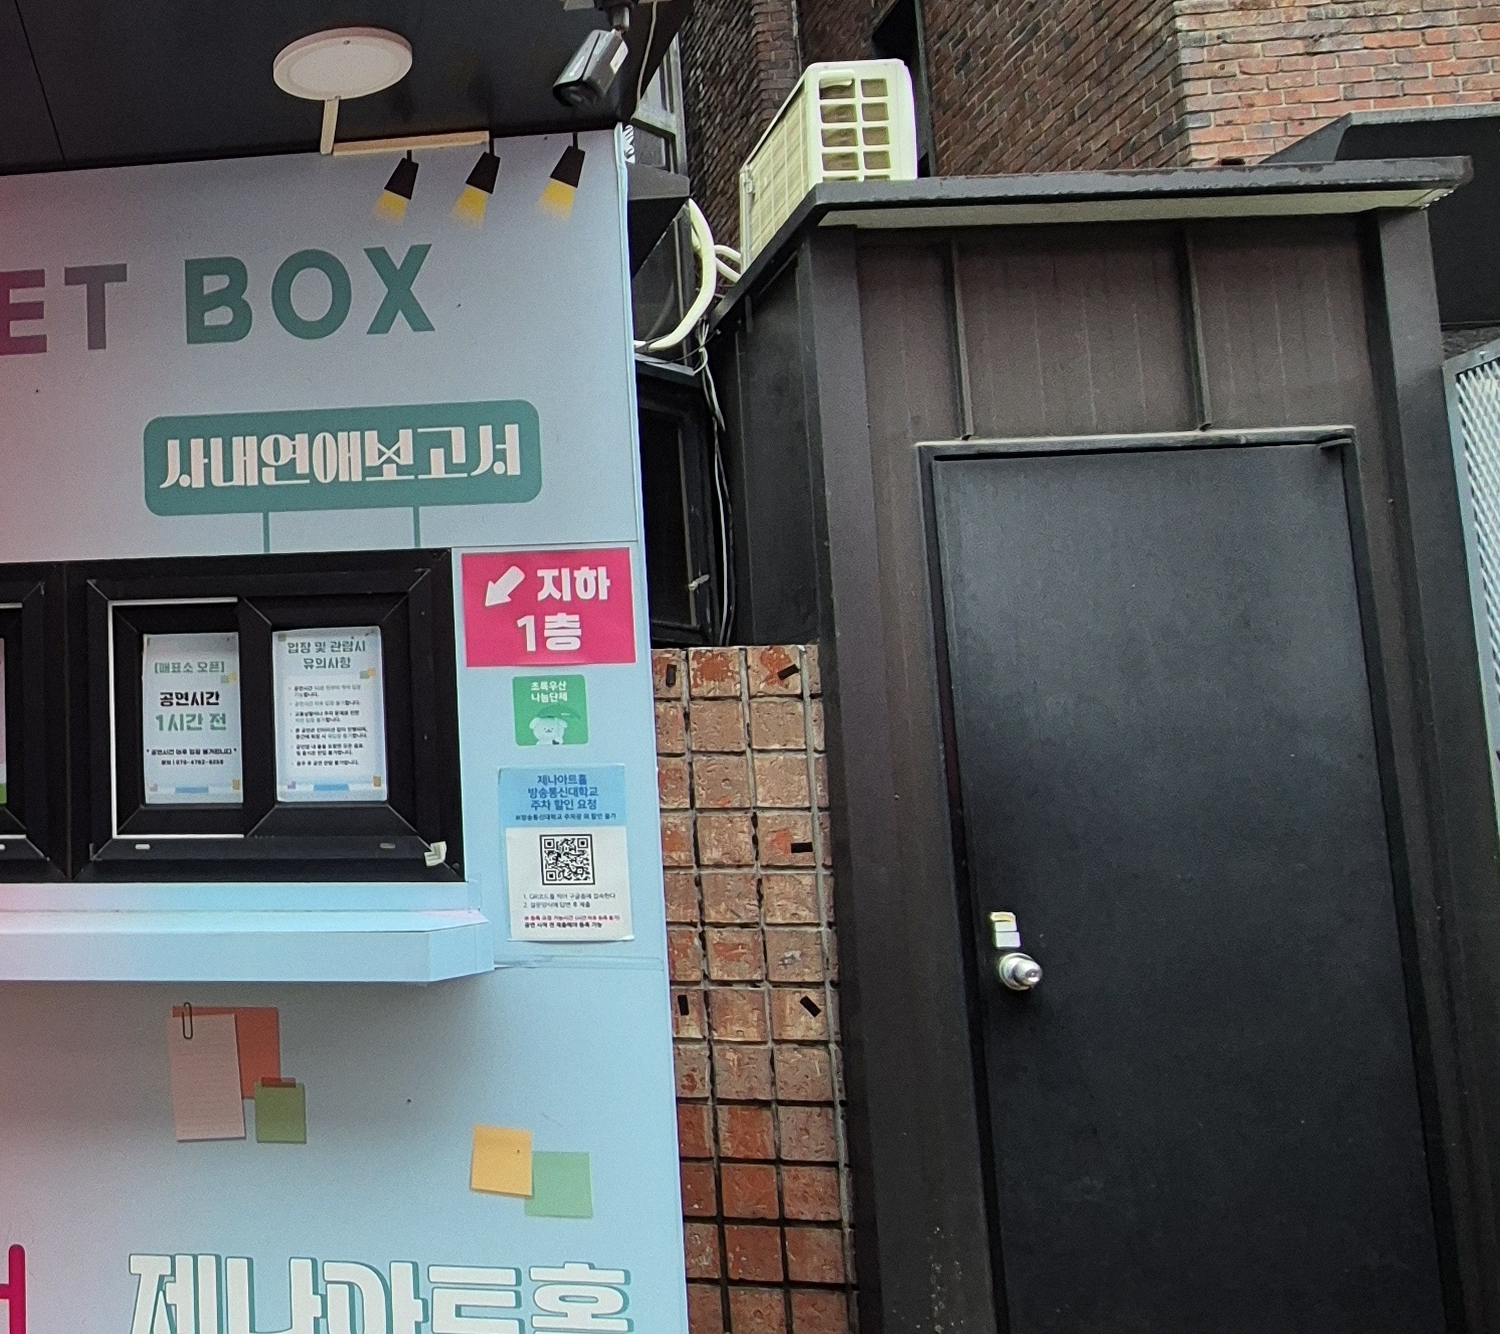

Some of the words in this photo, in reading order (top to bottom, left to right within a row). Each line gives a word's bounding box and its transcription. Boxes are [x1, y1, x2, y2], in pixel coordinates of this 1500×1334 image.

[184, 243, 436, 346] BOX
[159, 422, 522, 492] 사내연애보고서
[536, 567, 611, 604] 지하
[517, 612, 582, 653] 1층
[287, 641, 310, 654] 입장
[315, 641, 326, 653] 및
[303, 657, 351, 669] 유의사항
[530, 680, 567, 692] 초록우산
[160, 691, 220, 707] 공연시간
[531, 692, 568, 703] 나눔단체
[155, 713, 204, 732] 1시간
[209, 713, 227, 731] 전
[537, 773, 587, 786] 제나아트홀
[528, 786, 599, 799] 방송통신대학교
[530, 799, 551, 811] 주차
[554, 799, 574, 810] 할인
[578, 799, 597, 810] 요청
